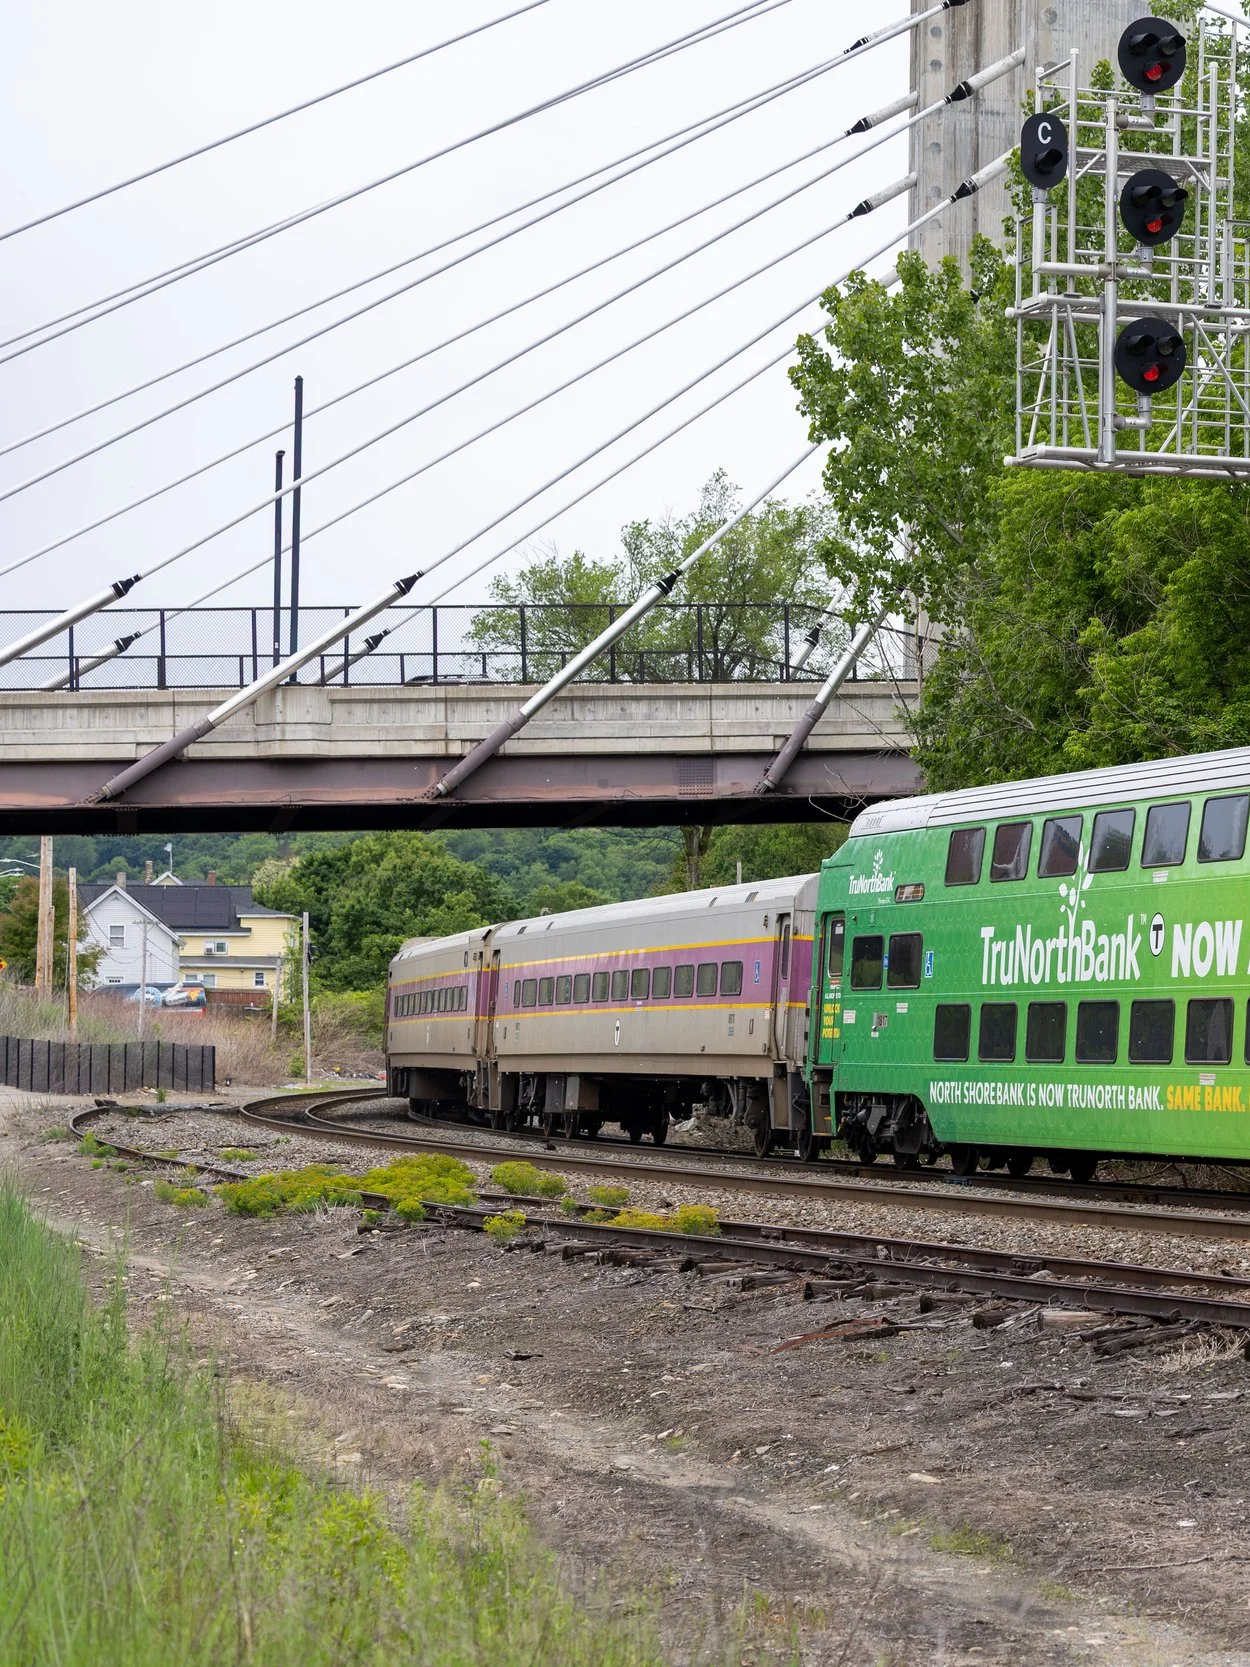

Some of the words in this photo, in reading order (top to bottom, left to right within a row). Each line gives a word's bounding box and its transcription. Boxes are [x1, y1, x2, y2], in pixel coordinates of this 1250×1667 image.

[1038, 121, 1052, 144] C
[849, 871, 894, 895] TruNorthBank
[981, 914, 1142, 985] TruNorthBank
[1152, 923, 1163, 950] T
[1171, 920, 1243, 978] NOW
[929, 1081, 962, 1104] NORTH
[963, 1081, 996, 1105] SHORE
[996, 1082, 1025, 1106] BANK
[1026, 1082, 1037, 1107] IS
[1038, 1083, 1065, 1108] NOW
[1066, 1083, 1126, 1110] TRUNORTH
[1128, 1085, 1164, 1111] BANK.
[1167, 1085, 1201, 1111] SAME
[1204, 1086, 1246, 1113] BANK.
